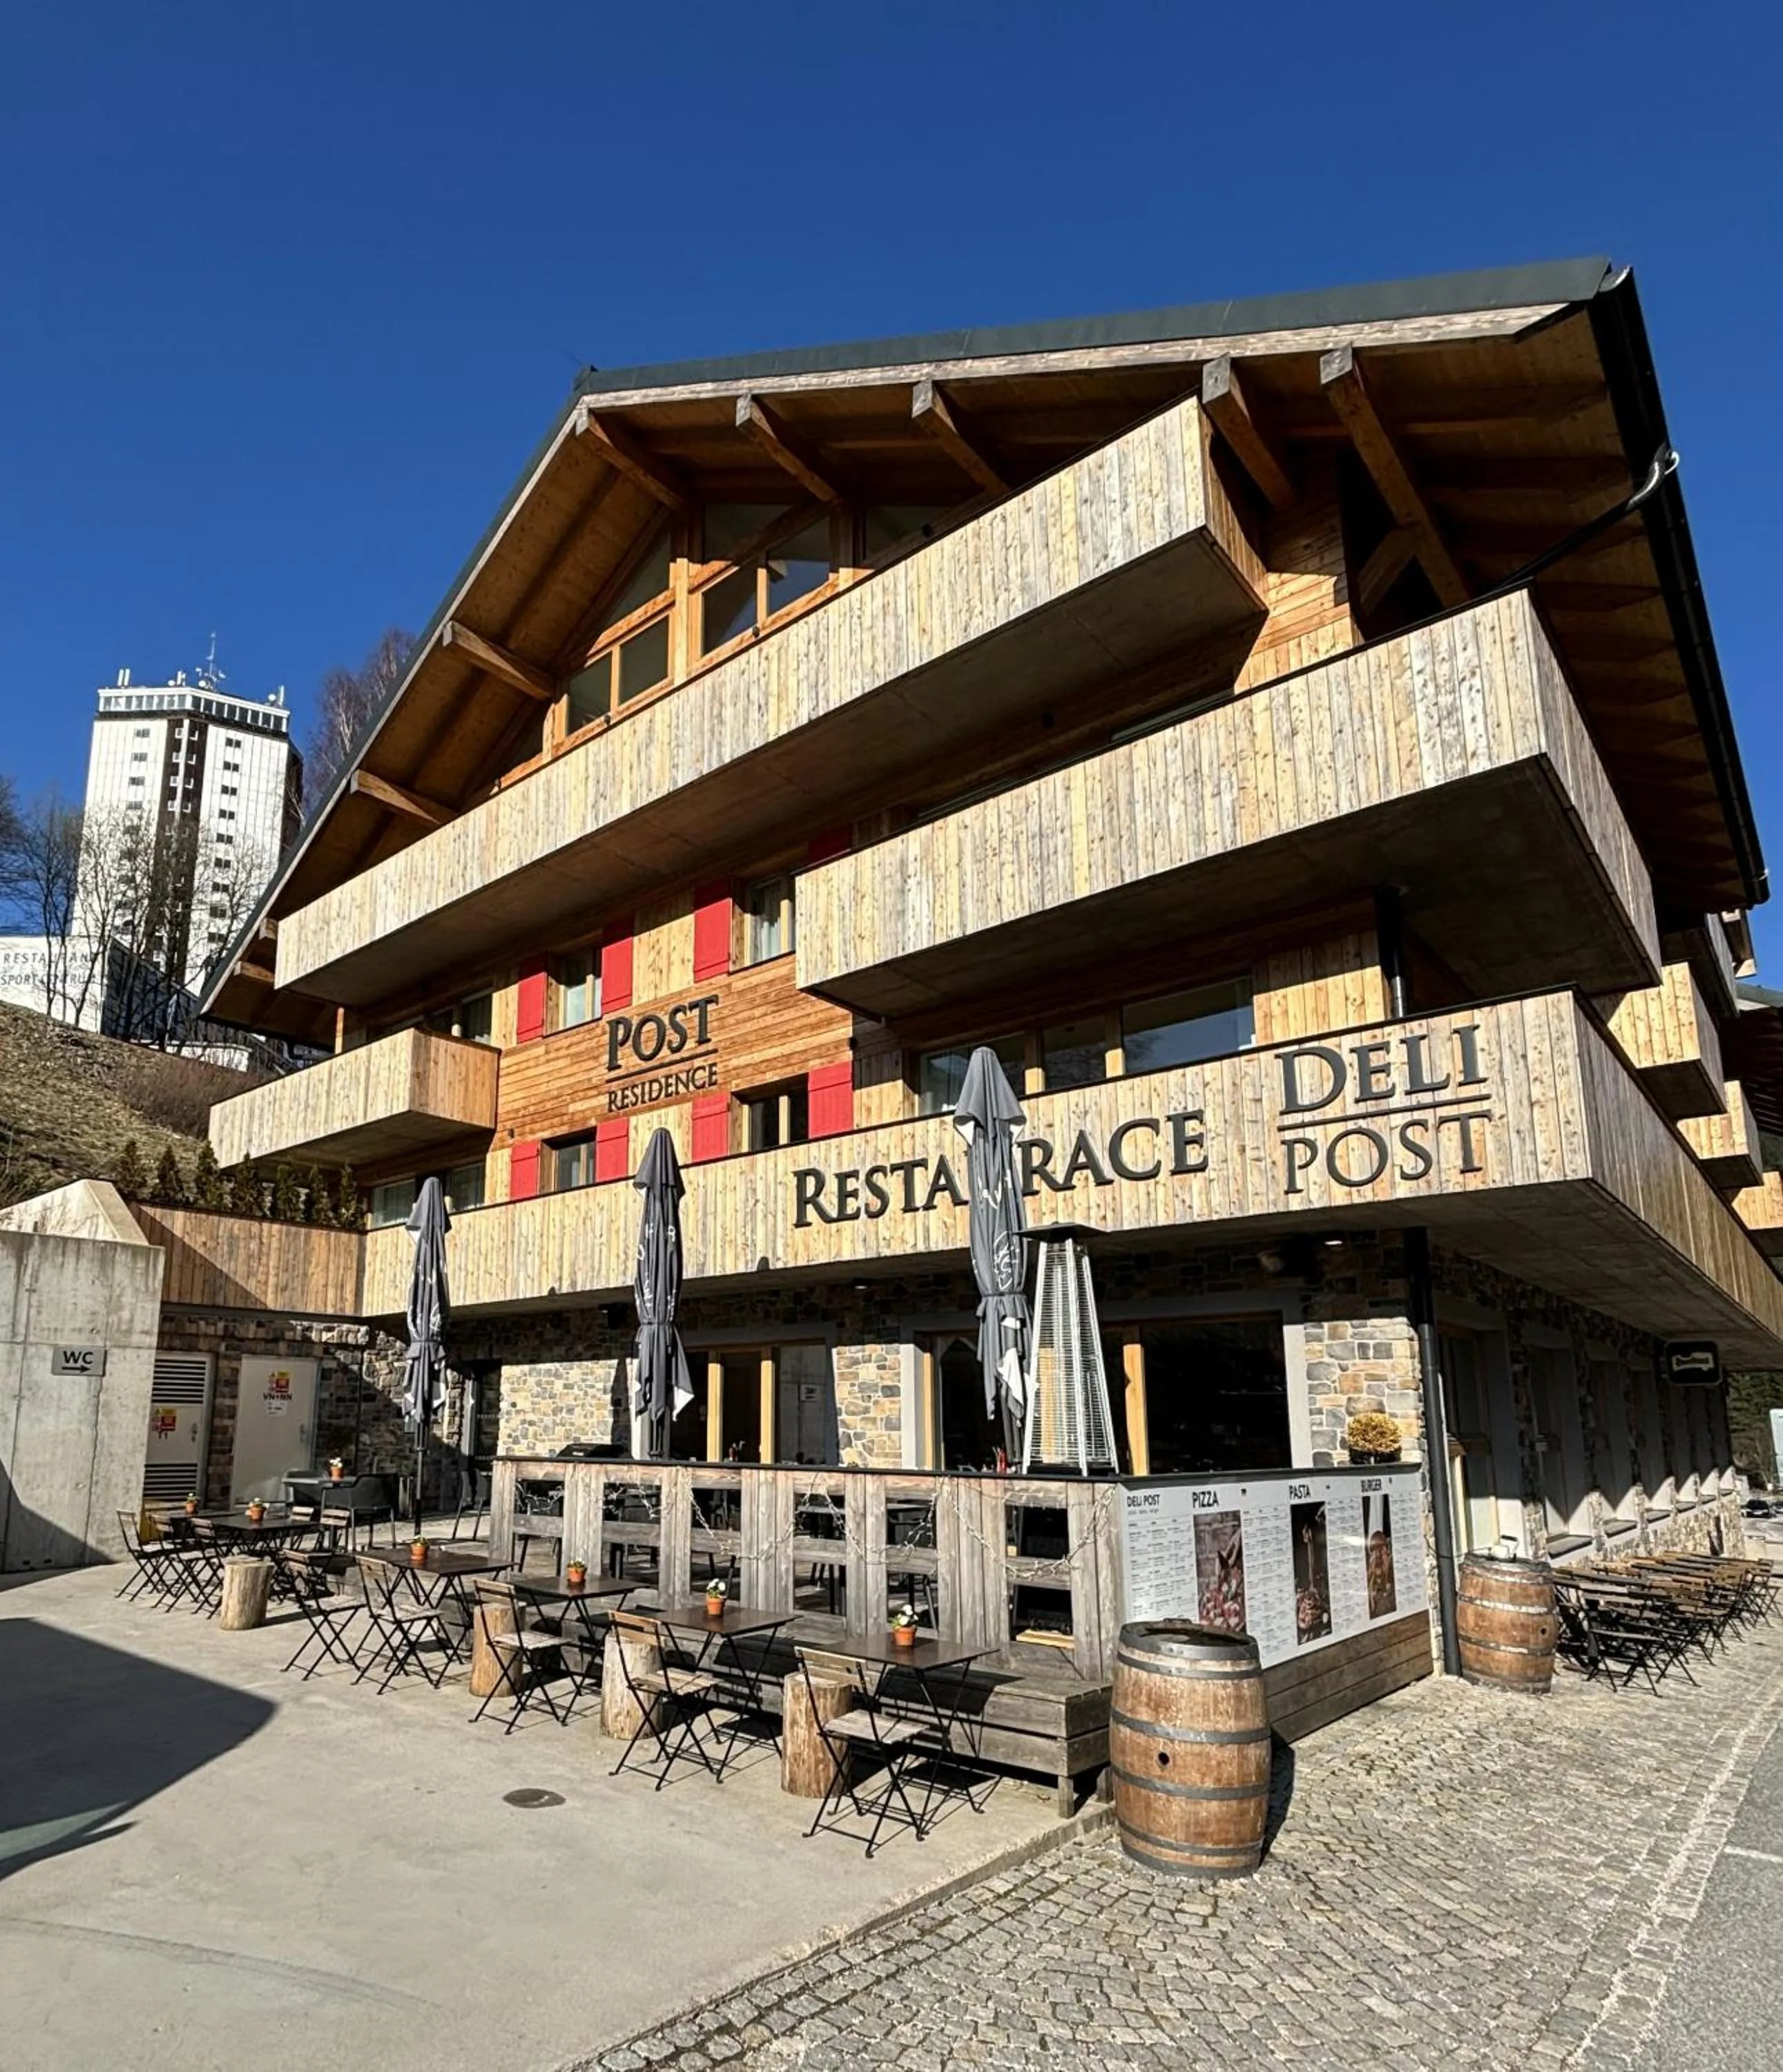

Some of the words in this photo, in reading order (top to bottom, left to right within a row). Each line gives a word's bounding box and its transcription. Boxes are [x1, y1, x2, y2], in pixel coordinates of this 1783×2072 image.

[606, 994, 719, 1071] POST
[607, 1062, 718, 1113] RESIDENCE
[1274, 1024, 1489, 1116] DELI
[791, 1109, 1209, 1228] RESTARACE
[1280, 1109, 1492, 1196] POST
[63, 1350, 94, 1365] WC
[1143, 1493, 1161, 1507] POST
[1193, 1490, 1219, 1508] PIZZA
[1289, 1484, 1311, 1500] PASTA
